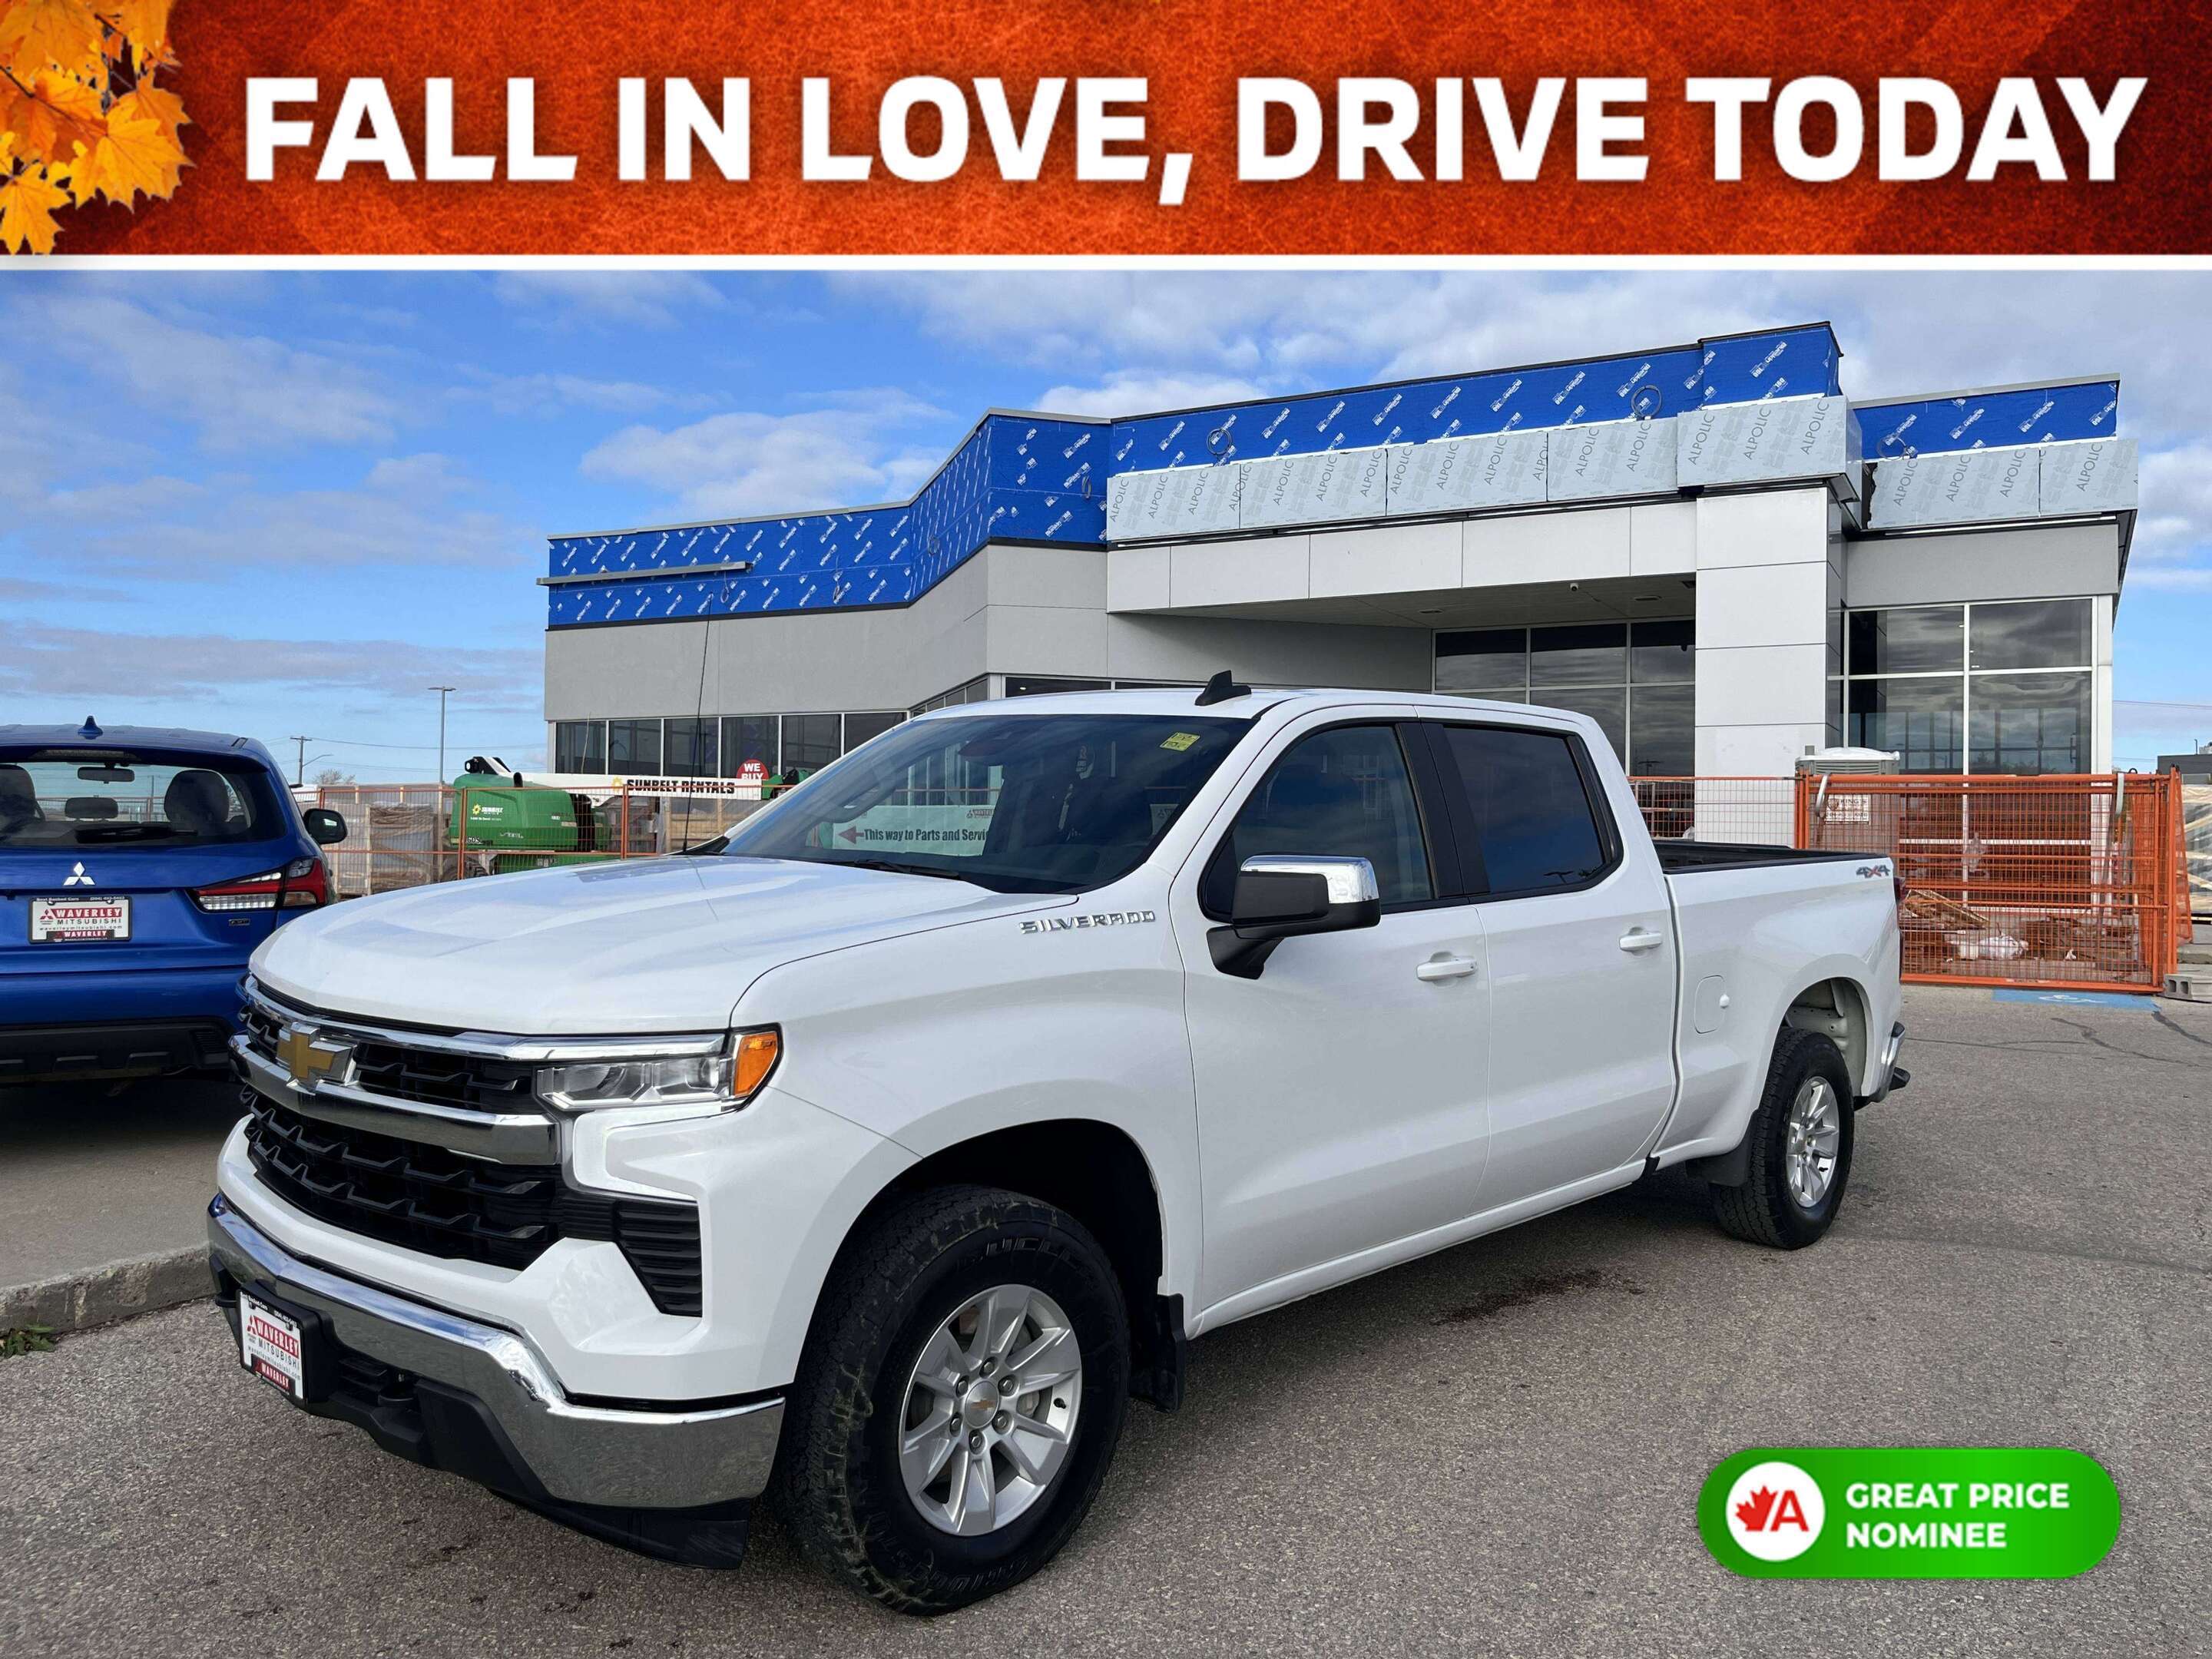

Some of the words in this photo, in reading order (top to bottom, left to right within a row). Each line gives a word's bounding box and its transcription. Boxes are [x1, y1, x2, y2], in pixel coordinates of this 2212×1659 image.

[1626, 422, 1651, 472] ALPOLIC
[1688, 413, 1714, 465] ALPOLIC
[1743, 407, 1771, 461] ALPOLIC
[1800, 400, 1830, 455] ALPOLIC
[1359, 451, 1382, 498] ALPOLIC
[1389, 448, 1412, 495] ALPOLIC
[1435, 442, 1459, 490] ALPOLIC
[1483, 436, 1507, 485] ALPOLIC
[1575, 427, 1599, 477] ALPOLIC
[1999, 450, 2026, 498] ALPOLIC
[2076, 444, 2102, 492] ALPOLIC
[1109, 478, 1130, 522] ALPOLIC
[1148, 475, 1168, 519] ALPOLIC
[1188, 472, 1209, 515] ALPOLIC
[1229, 465, 1252, 512] ALPOLIC
[1273, 460, 1294, 505] ALPOLIC
[1316, 455, 1337, 502] ALPOLIC
[1892, 460, 1918, 507] ALPOLIC
[1945, 454, 1971, 502] ALPOLIC
[627, 779, 678, 792] SUNBELT
[681, 780, 735, 794] RENTALS
[743, 763, 760, 772] WE
[864, 829, 883, 840] This
[885, 831, 902, 842] way
[905, 830, 913, 840] to
[916, 829, 940, 841] Parts
[942, 829, 959, 841] and
[56, 909, 120, 918] WAVERLEY
[1019, 910, 1155, 934] SILVERADO
[257, 1320, 300, 1356] WAVERLEY
[258, 1338, 300, 1371] MITSUBISHI
[261, 1363, 290, 1389] WAVERLEY
